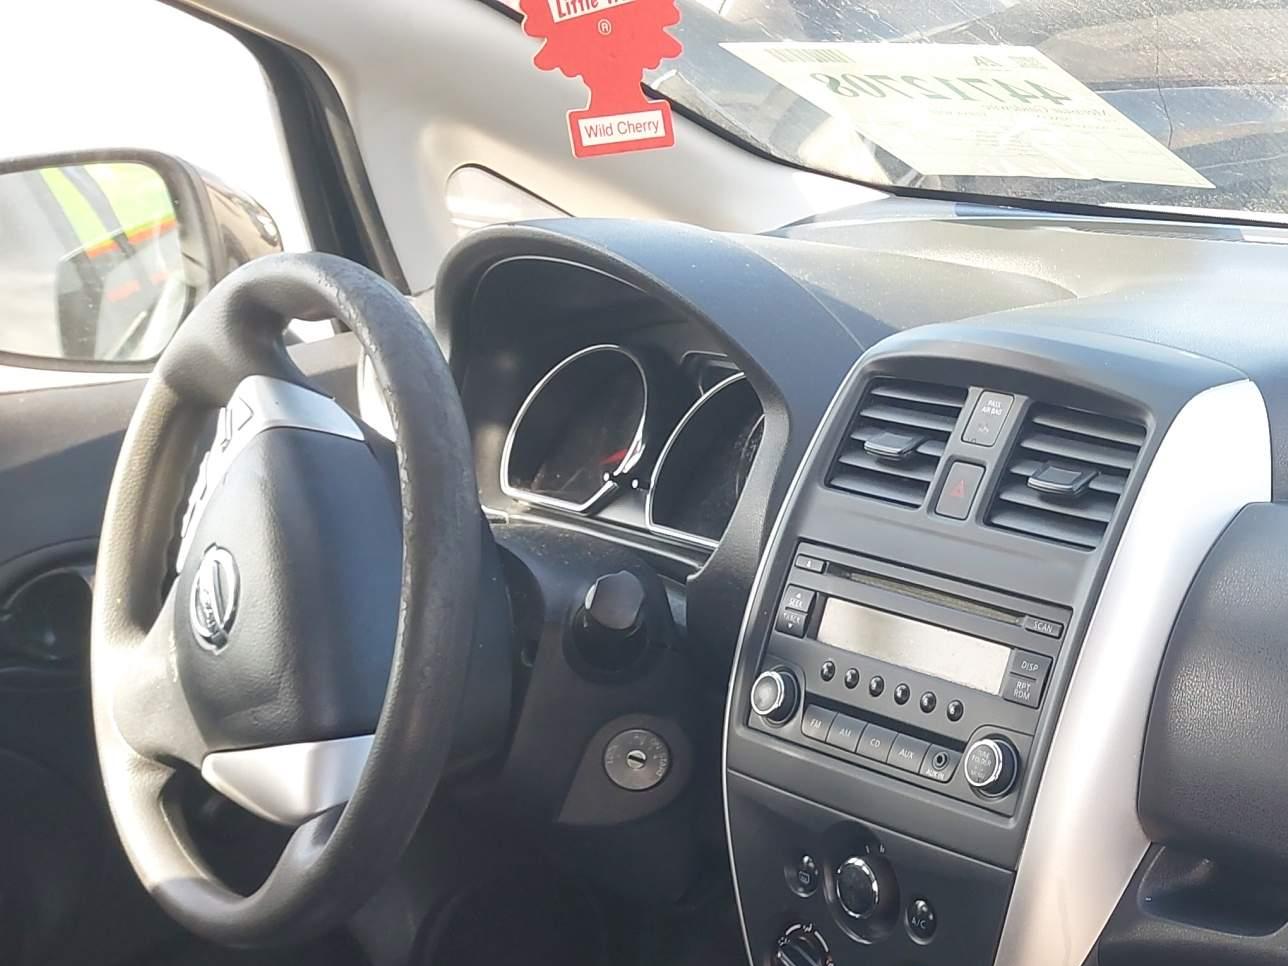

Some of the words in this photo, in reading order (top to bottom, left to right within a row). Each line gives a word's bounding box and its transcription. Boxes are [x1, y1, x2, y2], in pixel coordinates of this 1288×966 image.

[584, 122, 614, 138] Wild
[617, 120, 660, 135] Cherry
[1033, 621, 1053, 633] SCAN
[1021, 660, 1039, 672] DISP
[1016, 681, 1031, 692] RPT
[1013, 688, 1031, 700] RDM
[810, 718, 822, 729] FM
[839, 728, 851, 738] AM
[870, 738, 881, 748] CD
[899, 748, 914, 760] AUX
[911, 916, 927, 930] A/C
